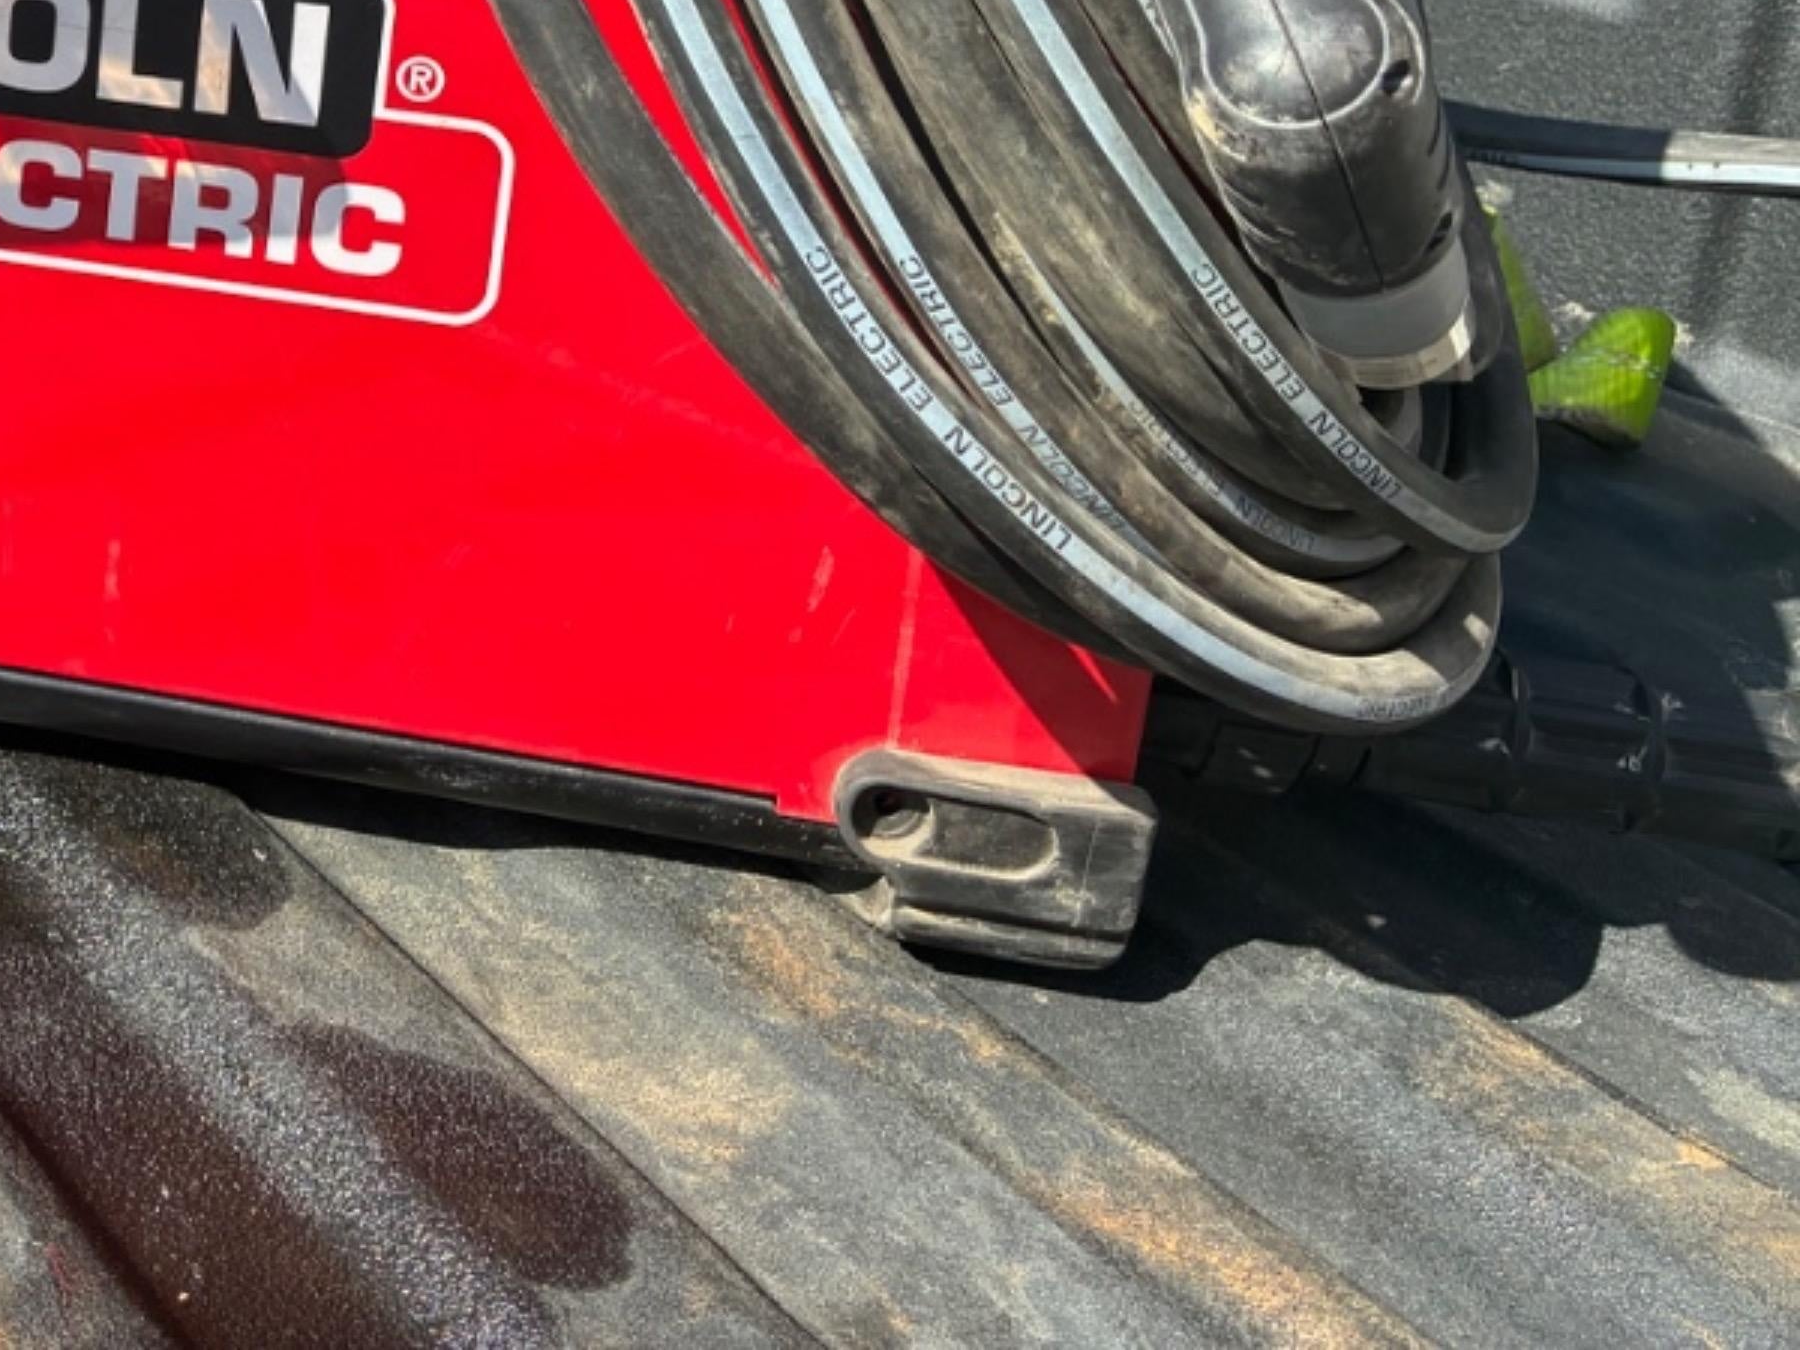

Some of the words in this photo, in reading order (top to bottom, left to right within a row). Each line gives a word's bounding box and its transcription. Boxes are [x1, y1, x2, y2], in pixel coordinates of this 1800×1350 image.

[805, 244, 934, 413] ELECTRIC
[900, 255, 1015, 407] ELECTRIC
[1191, 257, 1306, 402] ELECTRIC
[945, 424, 1074, 553] LINCOLN
[1020, 423, 1127, 532] LINCOLN
[1308, 409, 1403, 500] LINCOLN
